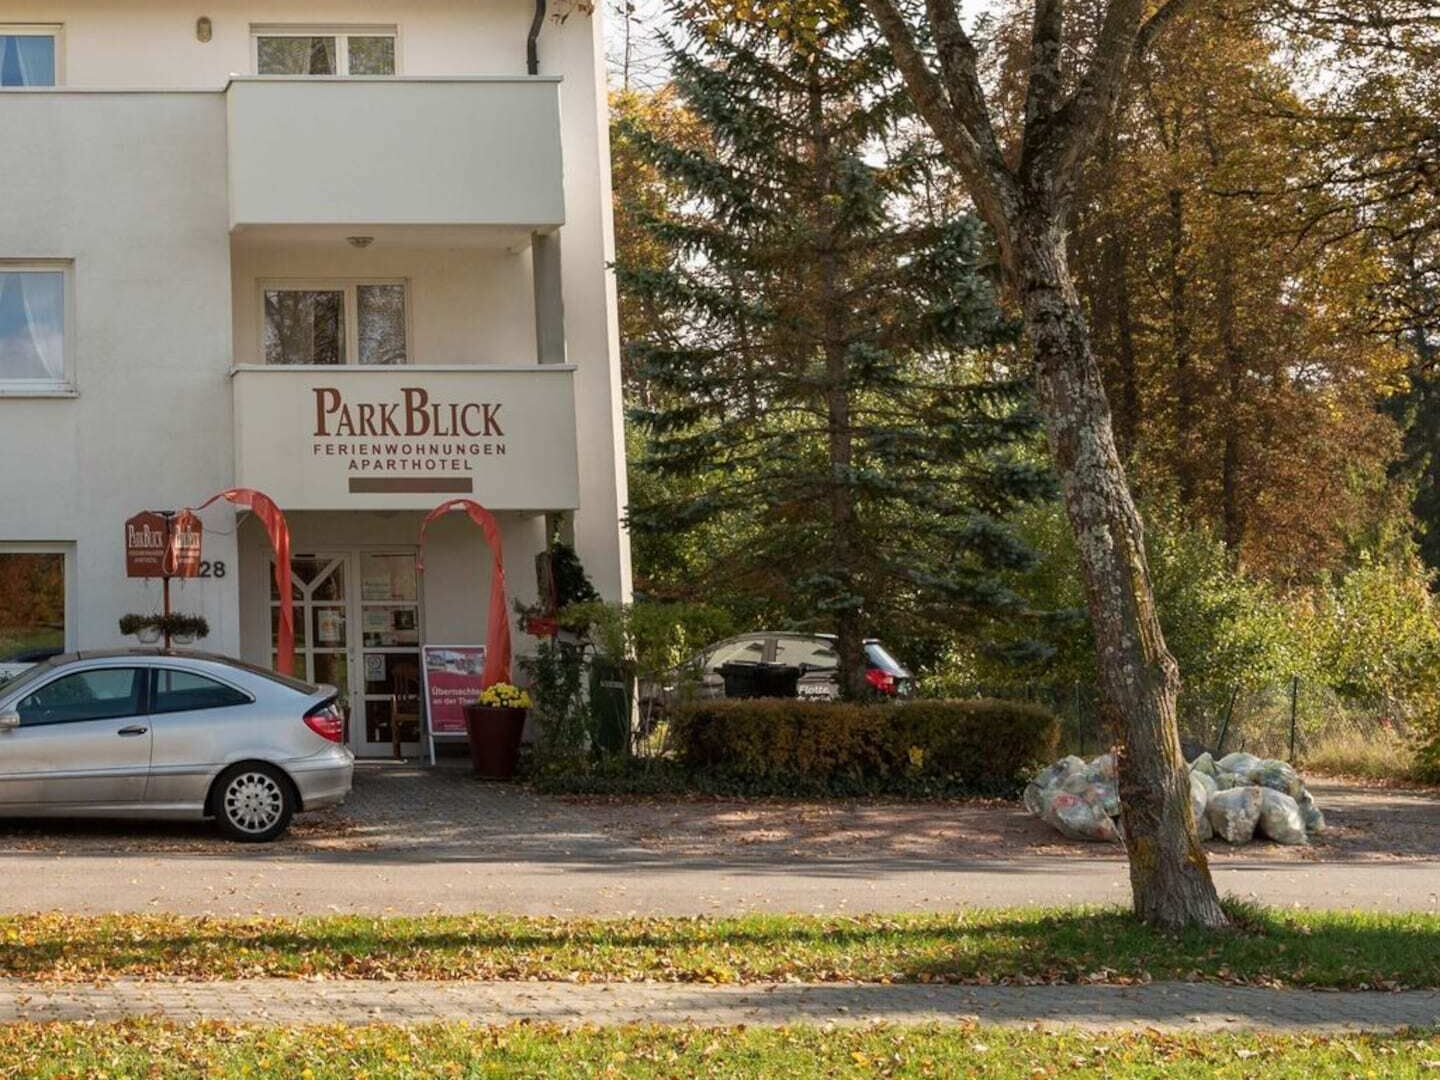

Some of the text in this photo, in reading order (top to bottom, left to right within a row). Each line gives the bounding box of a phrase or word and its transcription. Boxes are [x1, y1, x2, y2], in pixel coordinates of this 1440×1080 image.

[313, 443, 506, 455] FERIENWOHNUNGEN
[348, 459, 473, 470] APARTHOTEL
[200, 561, 225, 577] 28
[432, 686, 481, 696] Übernachte
